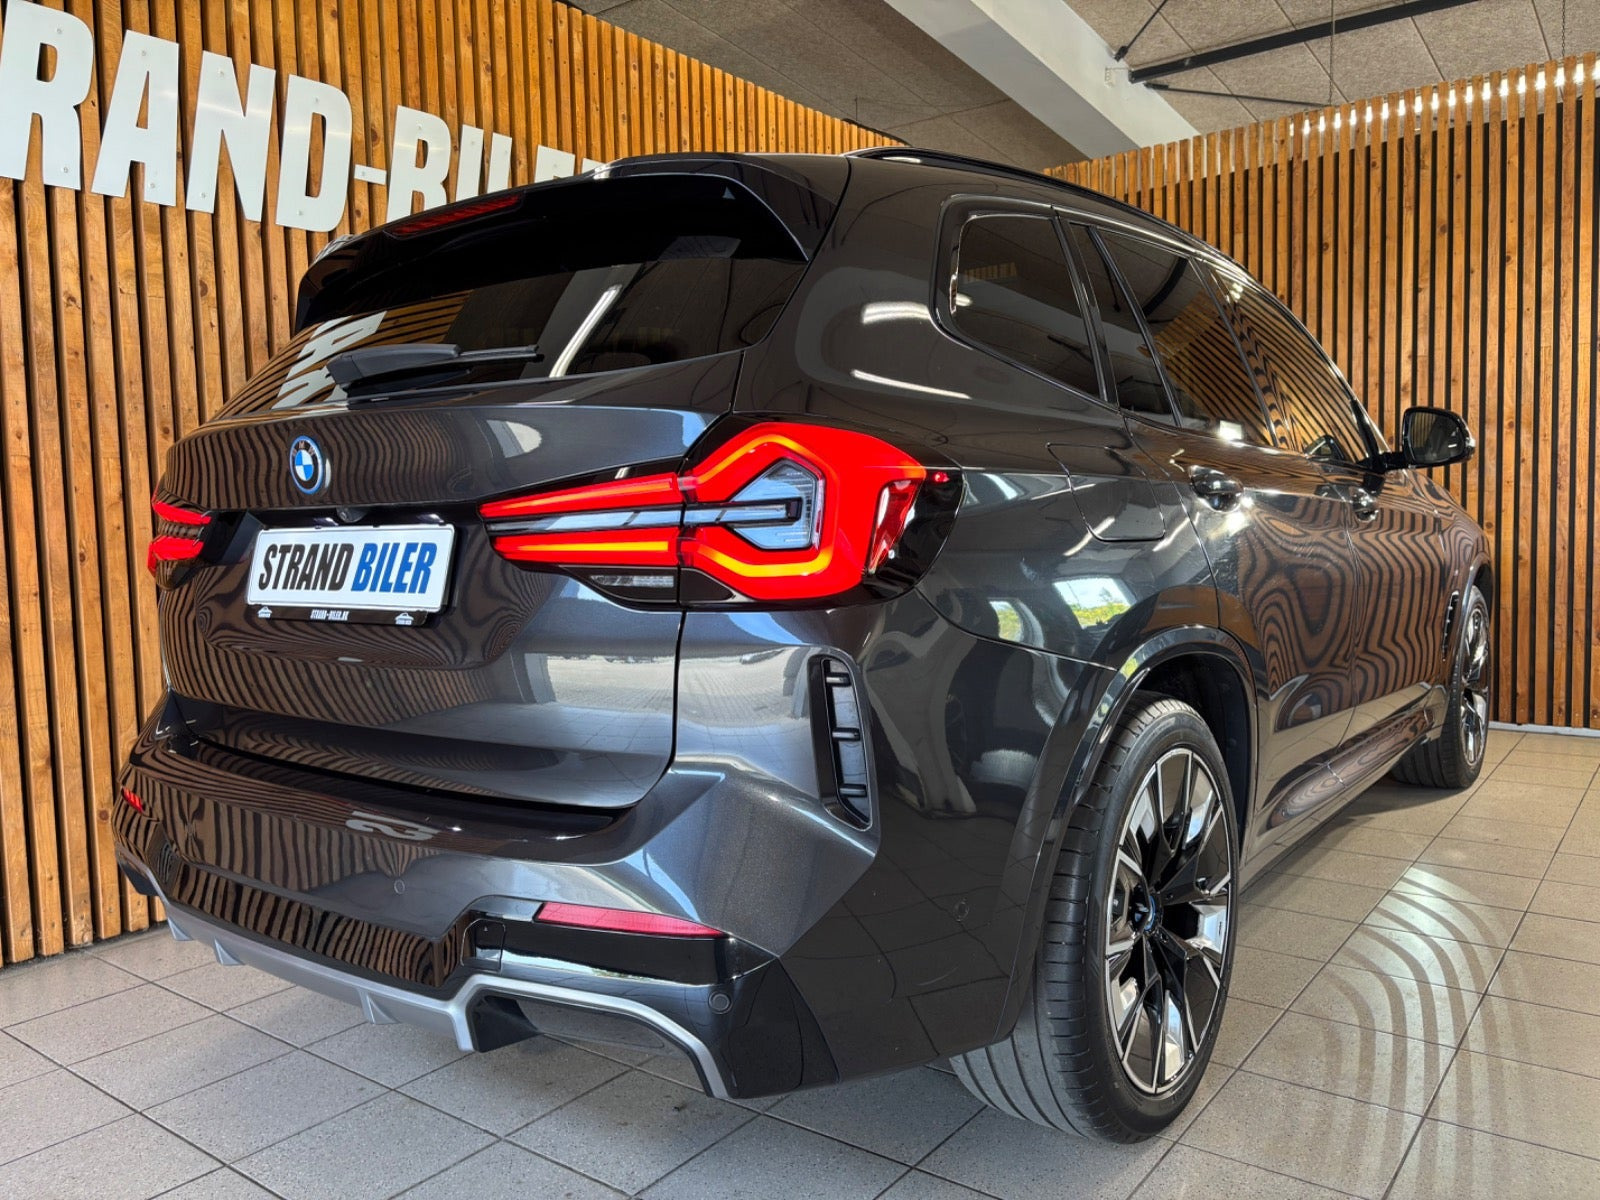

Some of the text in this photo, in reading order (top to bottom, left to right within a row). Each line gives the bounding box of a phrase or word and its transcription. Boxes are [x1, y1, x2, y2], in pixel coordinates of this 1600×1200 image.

[0, 0, 606, 232] RAND-BI
[258, 543, 437, 594] STRAND BILER
